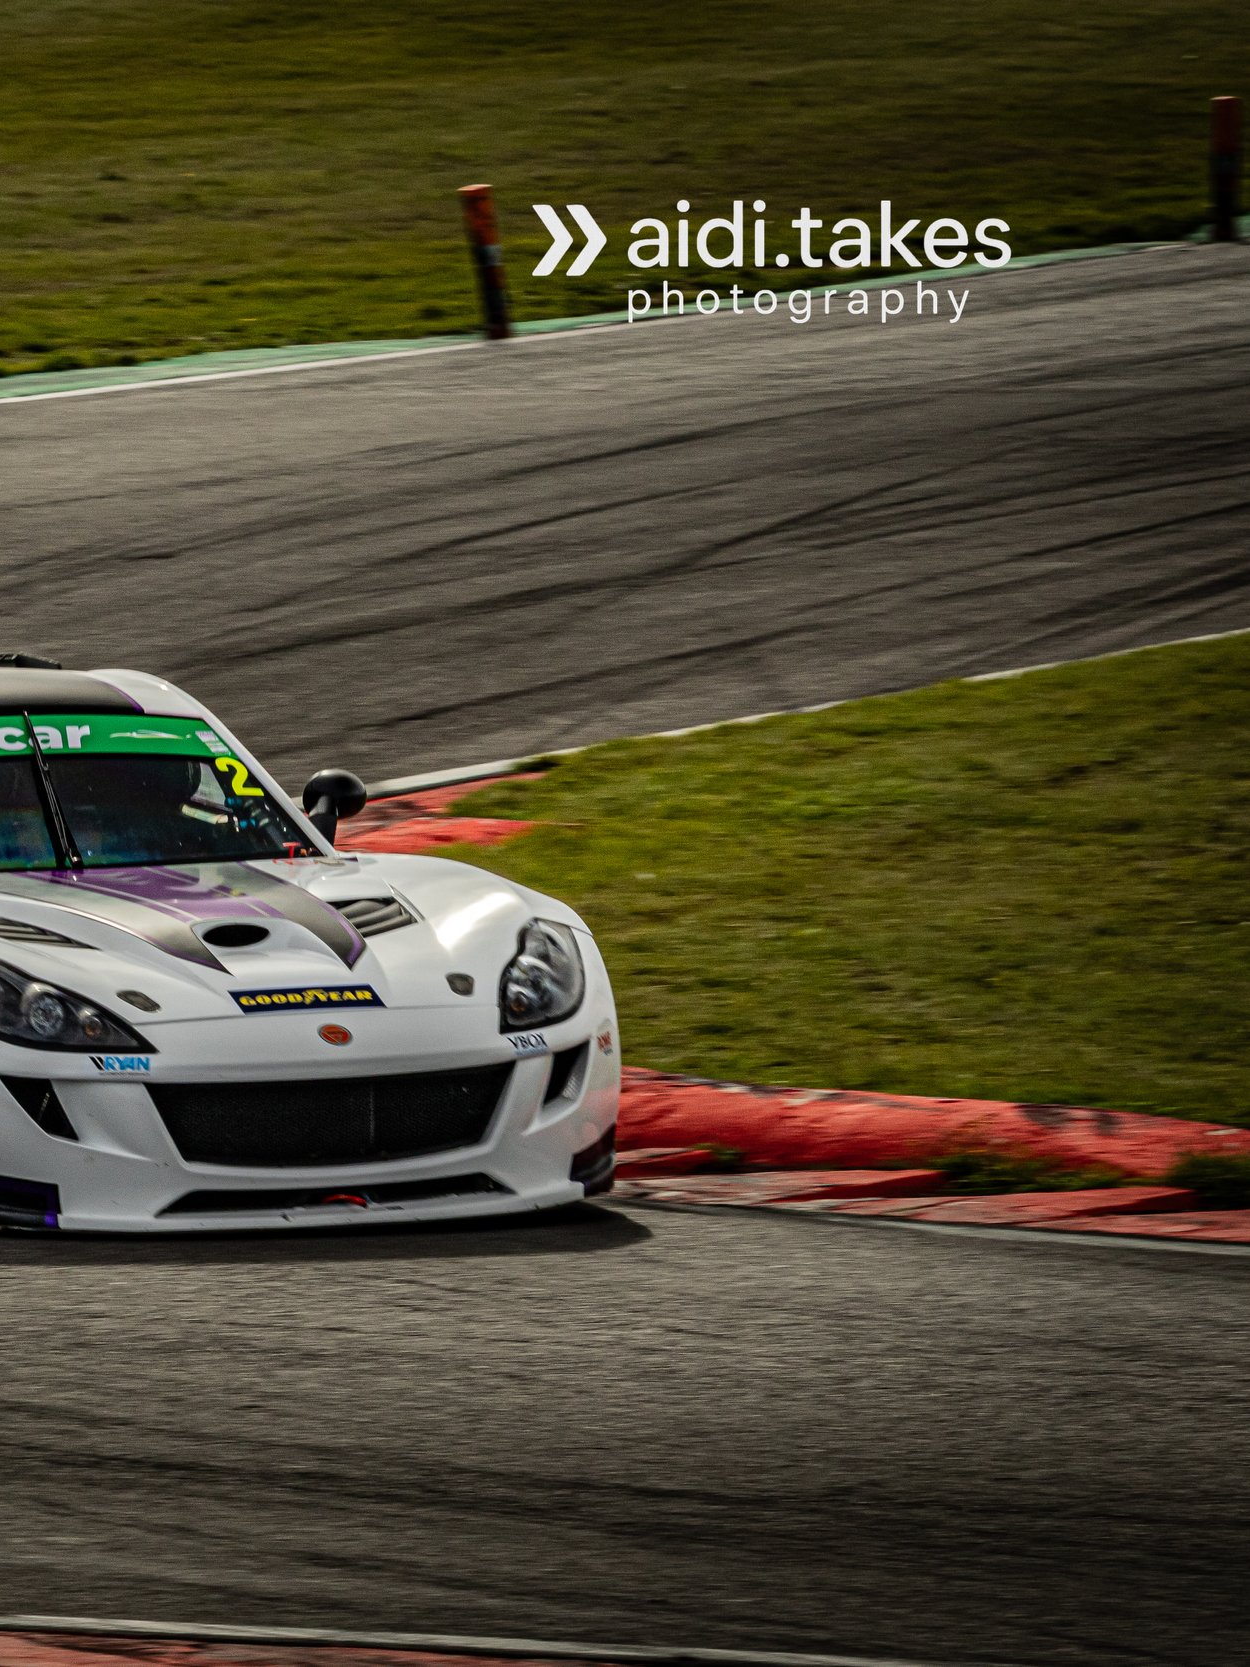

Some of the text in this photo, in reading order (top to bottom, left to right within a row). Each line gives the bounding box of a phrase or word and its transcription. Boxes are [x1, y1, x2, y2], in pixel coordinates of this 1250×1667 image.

[215, 757, 264, 796] 2
[239, 988, 373, 1006] GOODYEAR
[507, 1032, 548, 1050] VBOX
[103, 1055, 150, 1072] RYAN
